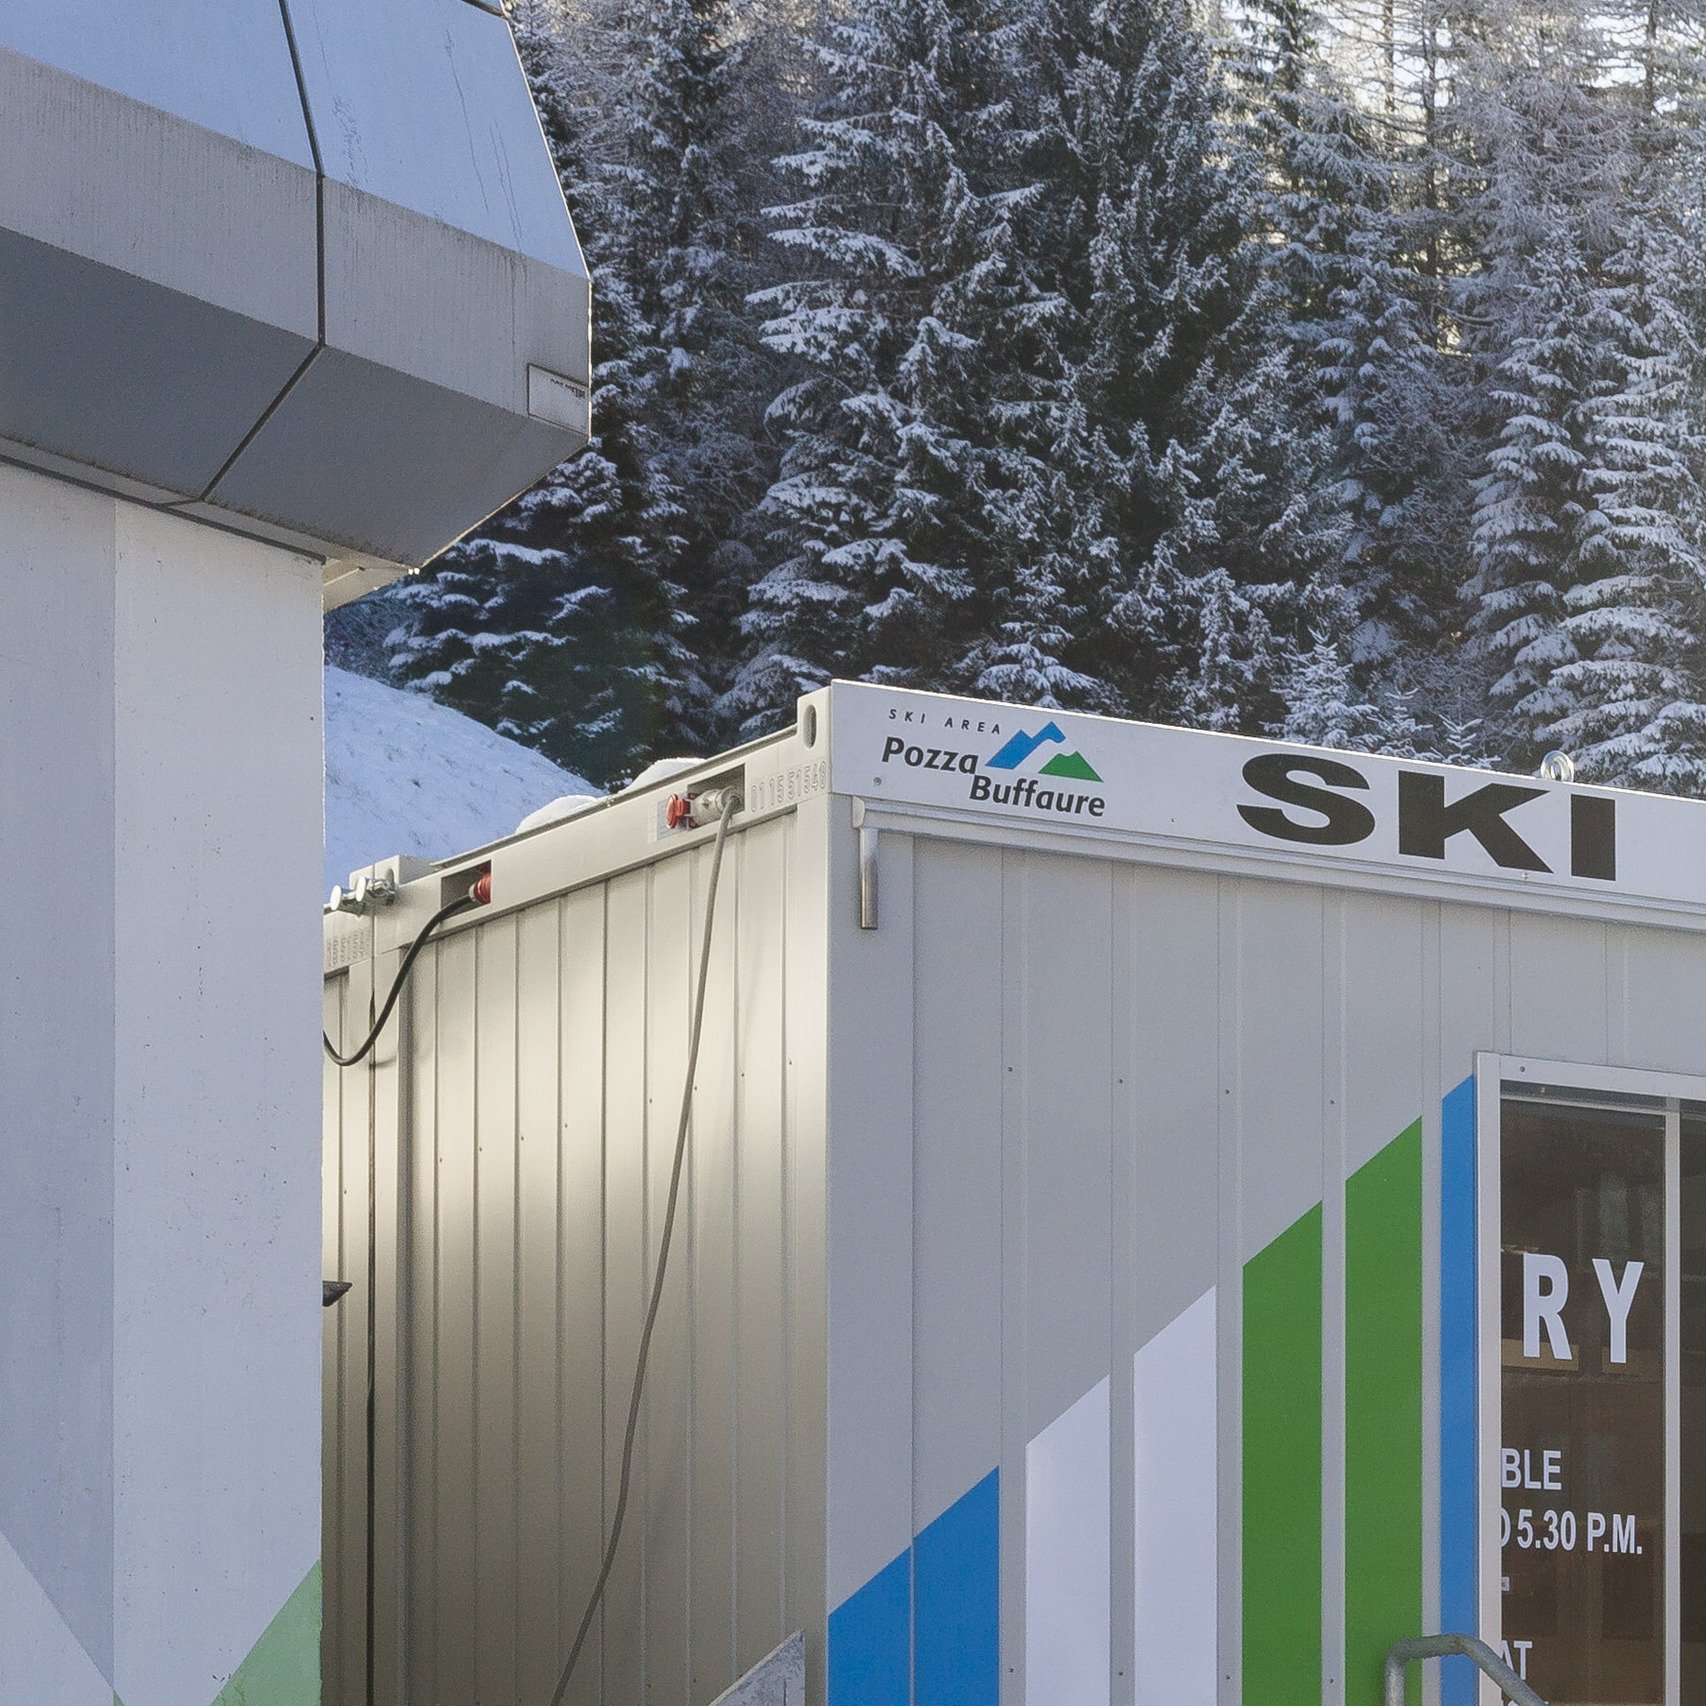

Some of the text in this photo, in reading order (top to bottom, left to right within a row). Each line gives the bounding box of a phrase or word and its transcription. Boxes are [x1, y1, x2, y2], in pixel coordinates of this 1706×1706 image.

[888, 708, 1001, 735] SKI AREA
[882, 736, 979, 775] Pozza
[969, 775, 1106, 817] Buffaure
[1237, 753, 1616, 882] SKI
[1501, 1447, 1562, 1491] BLE
[1516, 1508, 1577, 1551] 5.30
[1587, 1511, 1643, 1555] P.M.
